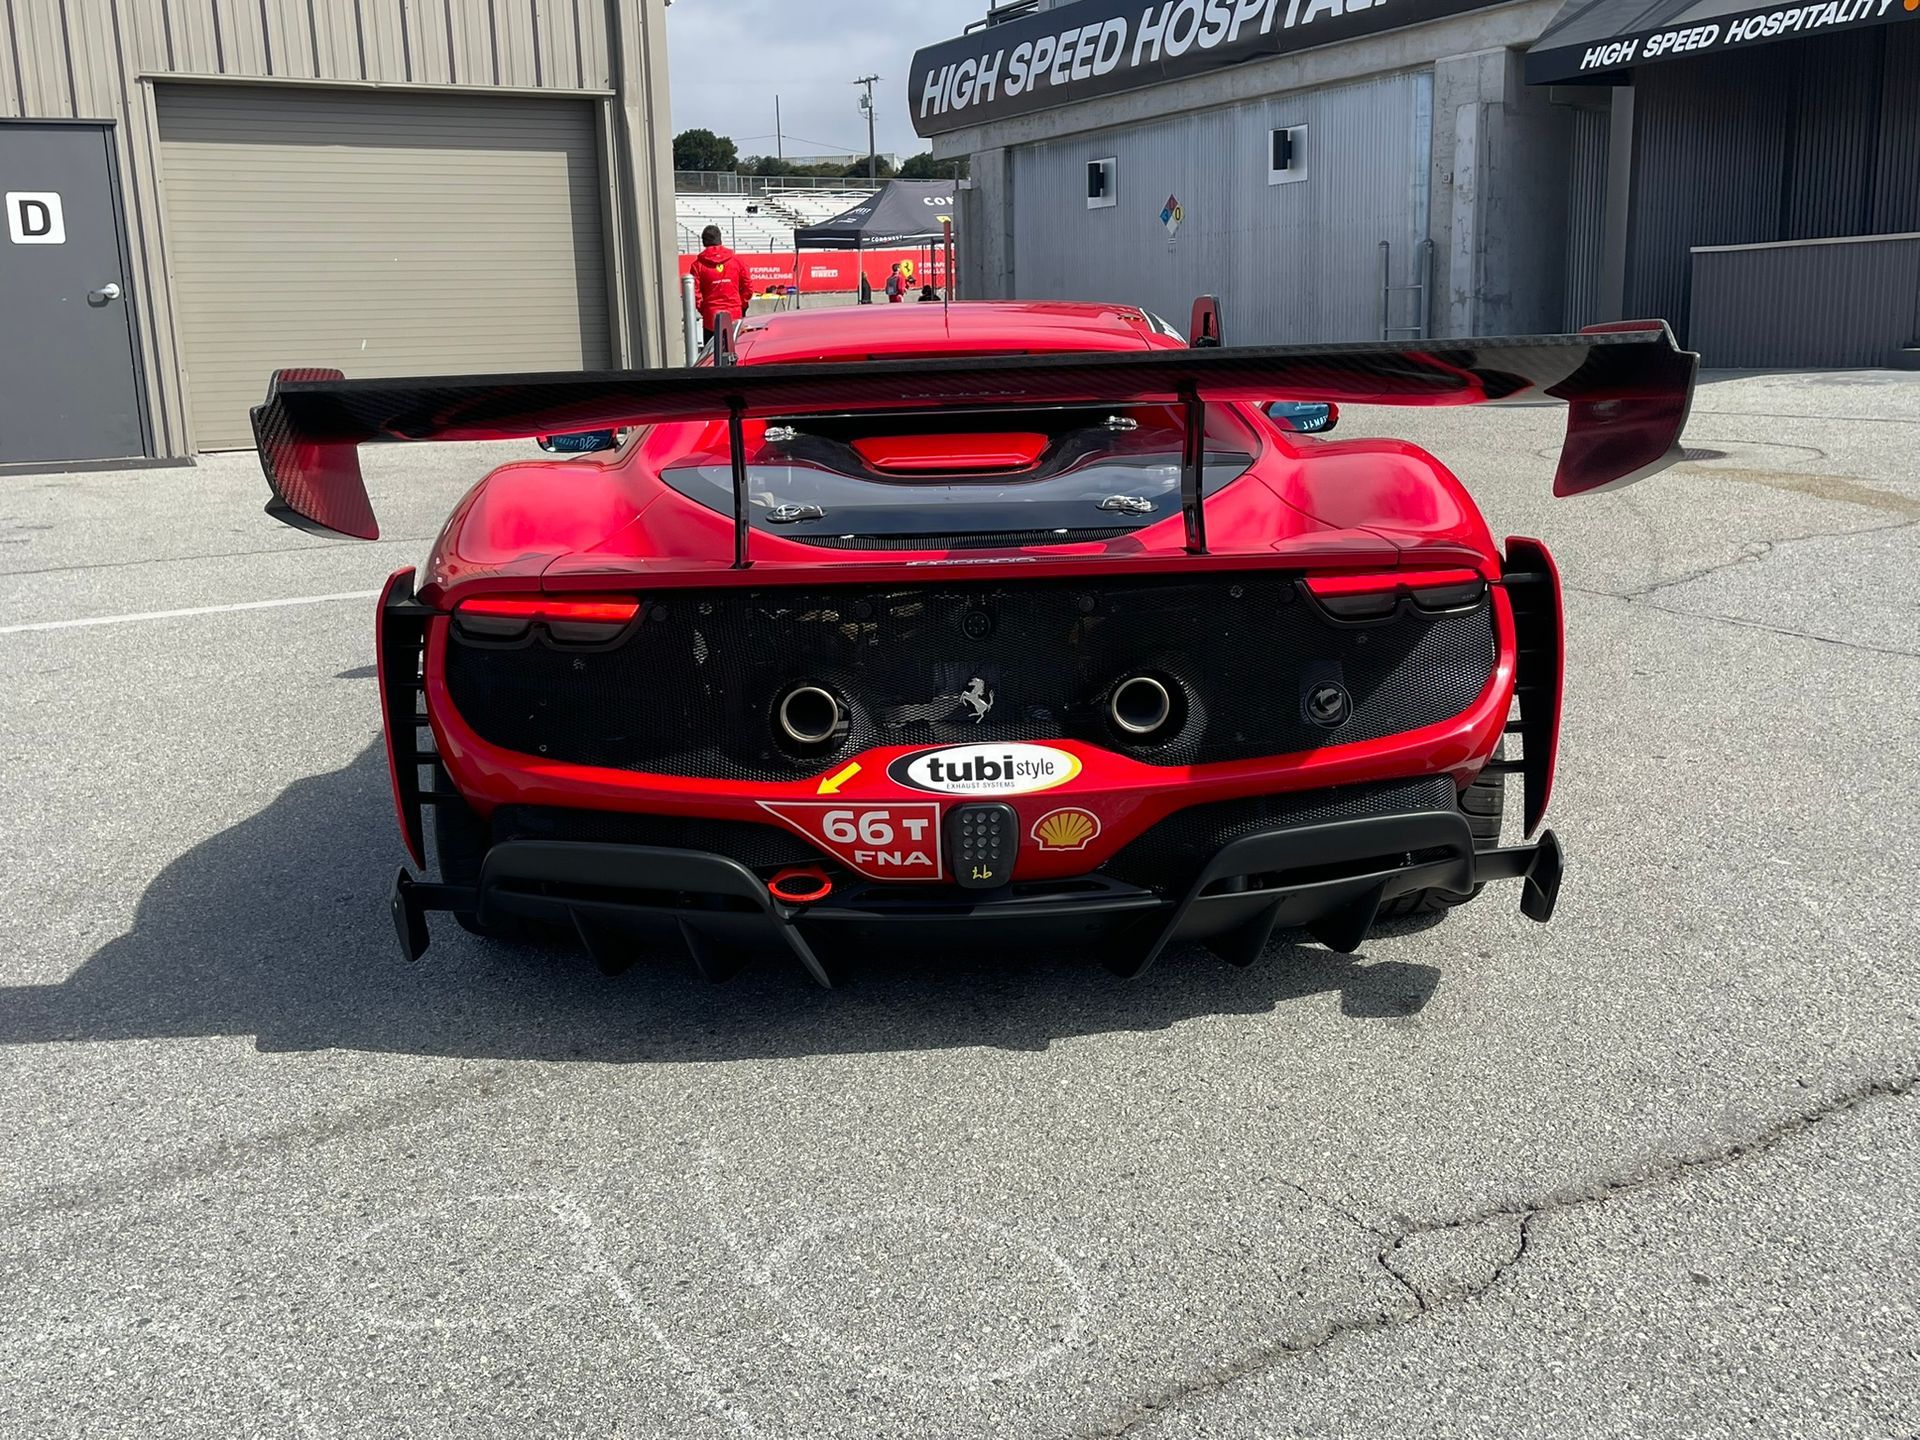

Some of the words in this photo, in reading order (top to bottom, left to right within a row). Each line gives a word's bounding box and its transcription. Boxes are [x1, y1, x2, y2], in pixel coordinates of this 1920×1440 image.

[1580, 39, 1639, 70] HIGH
[1642, 24, 1720, 58] SPEED
[1723, 0, 1892, 44] HOSPITALITY
[920, 50, 1004, 119] HIGH
[1004, 16, 1128, 97] SPEED
[1130, 0, 1387, 67] HOSPI
[18, 199, 52, 236] D
[926, 755, 1014, 783] tubi
[1016, 758, 1055, 779] style
[946, 782, 980, 790] EXHAUST
[822, 810, 894, 846] 66
[902, 819, 929, 841] T
[854, 850, 933, 866] FNA
